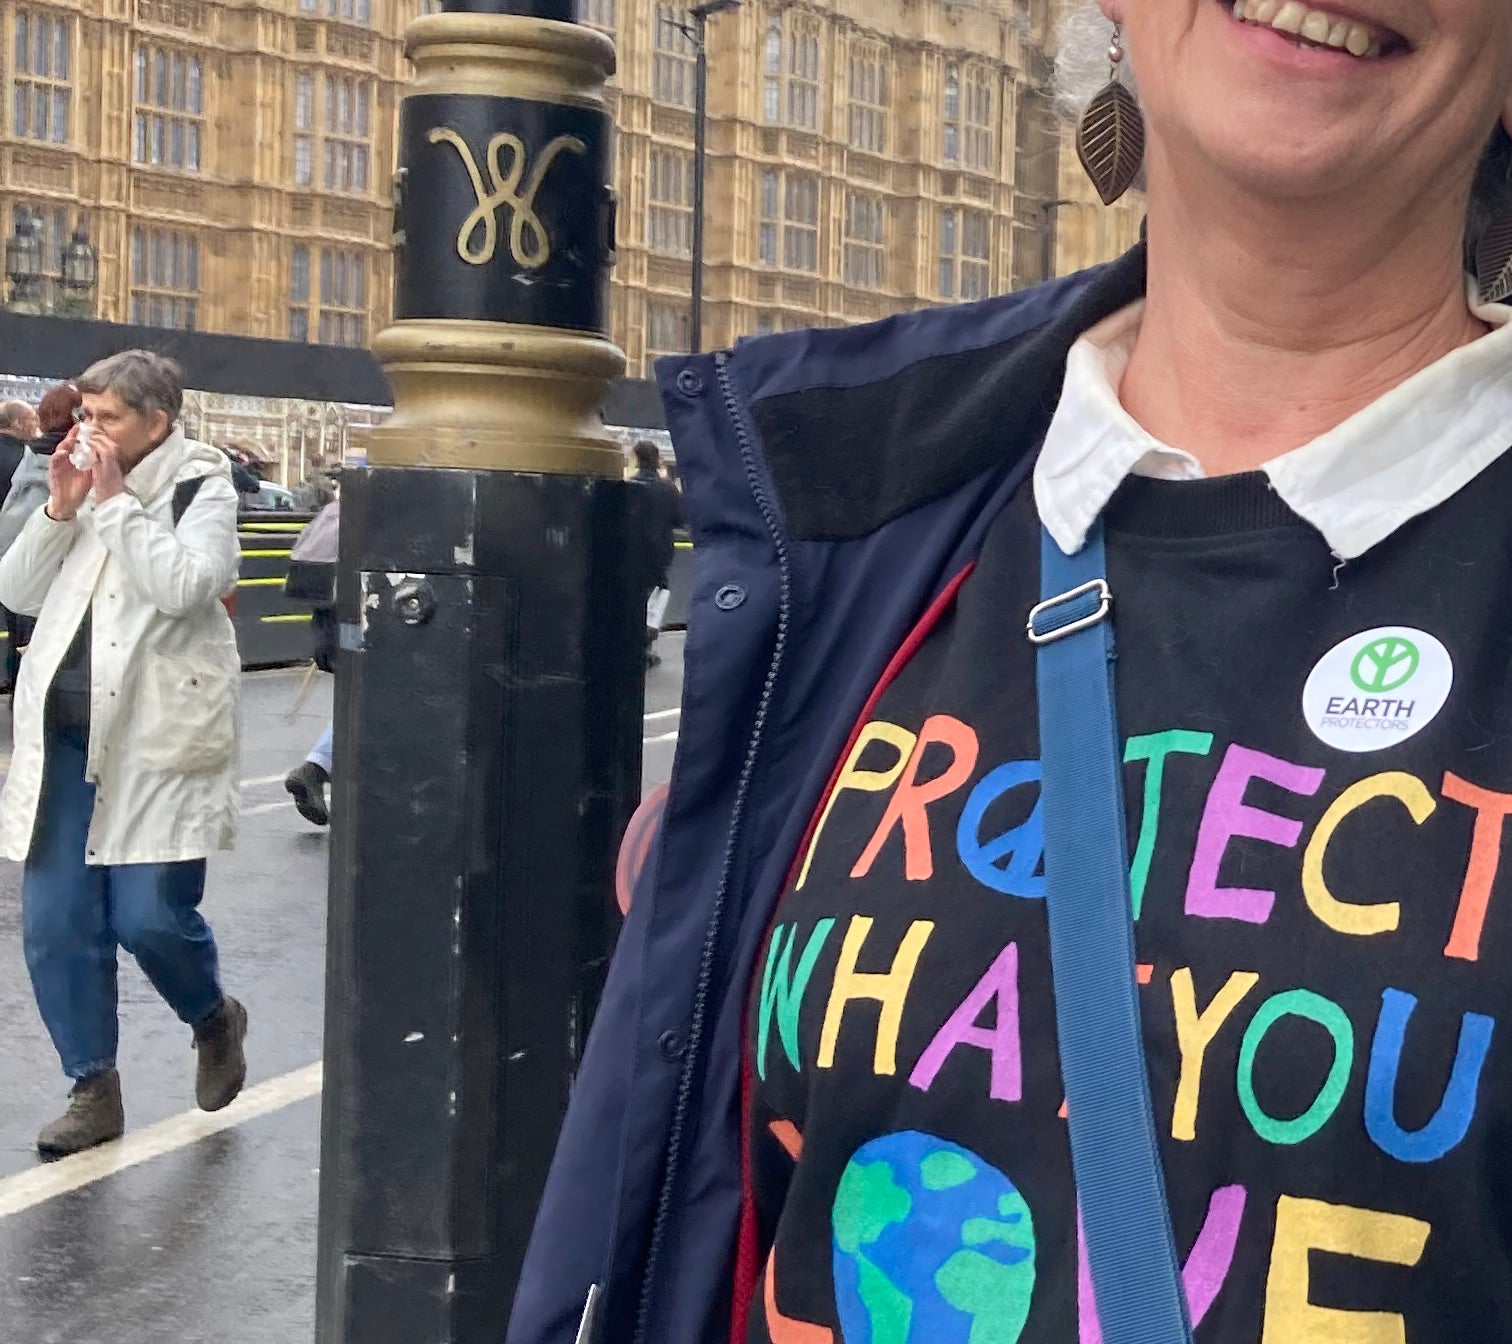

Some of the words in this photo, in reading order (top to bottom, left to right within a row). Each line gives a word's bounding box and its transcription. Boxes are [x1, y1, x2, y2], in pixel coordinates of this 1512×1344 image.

[1325, 696, 1415, 718] EARTH
[1319, 716, 1409, 731] PROTECTORS
[756, 914, 1153, 1119] WHA
[1169, 967, 1495, 1163] YOU
